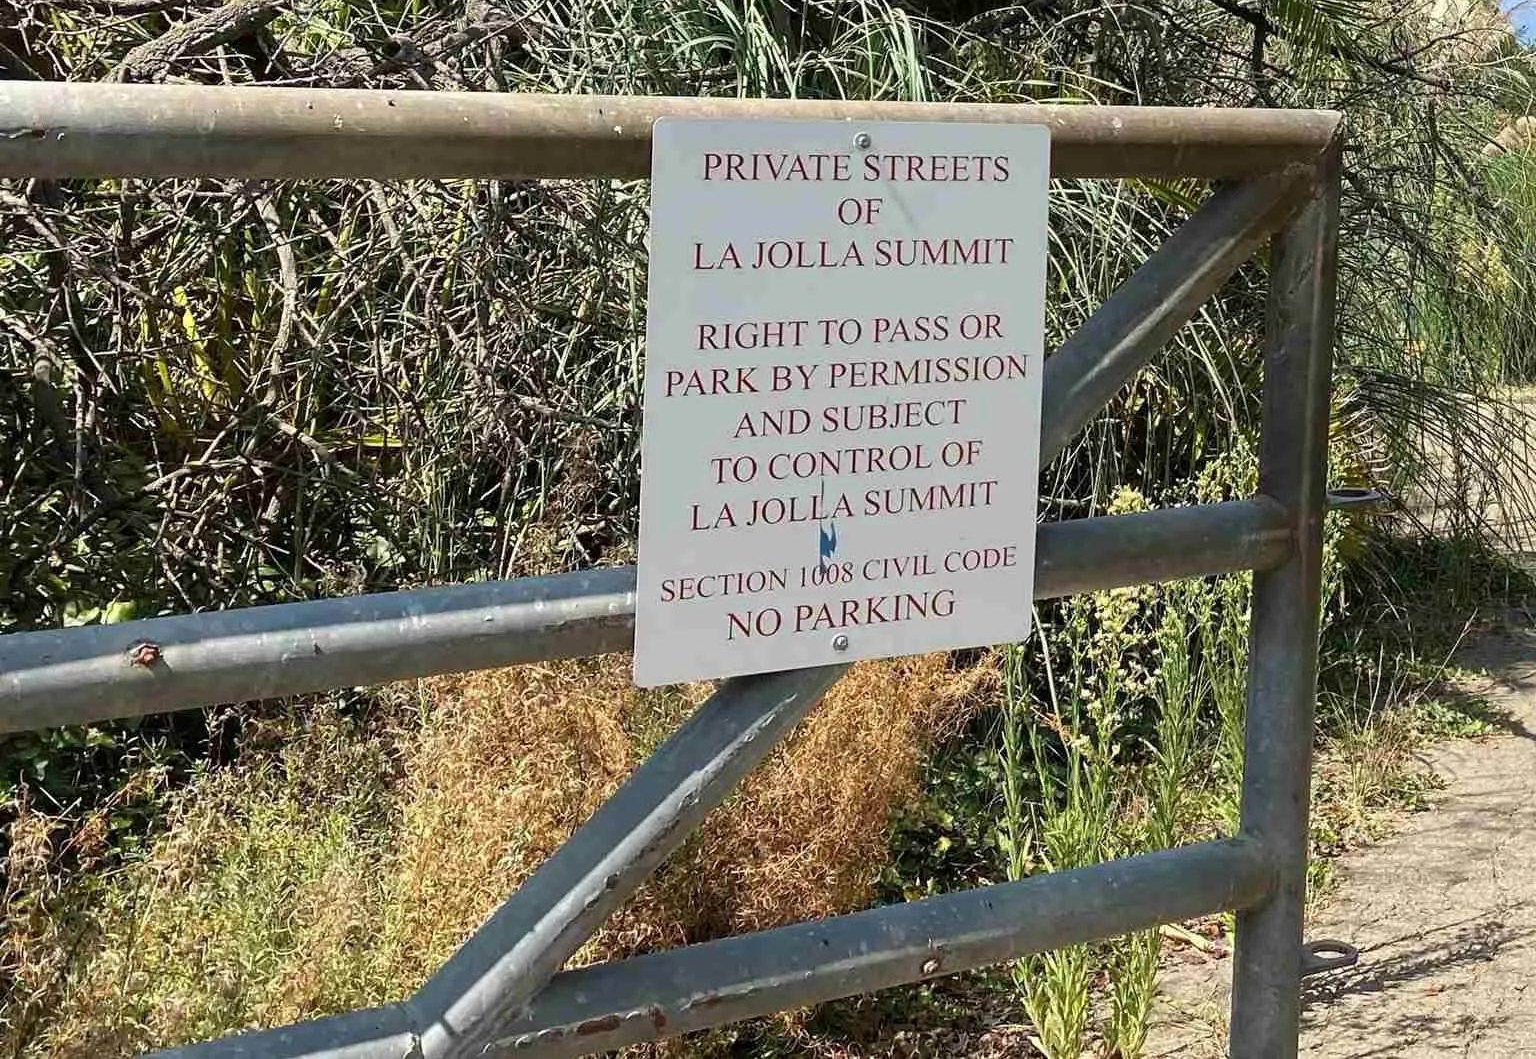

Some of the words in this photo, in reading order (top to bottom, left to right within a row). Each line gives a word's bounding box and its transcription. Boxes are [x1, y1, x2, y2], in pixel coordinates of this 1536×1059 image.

[704, 153, 851, 181] PRIVATE
[864, 155, 1010, 182] STREETS
[837, 198, 883, 225] OF
[694, 242, 742, 270] LA
[752, 241, 864, 269] JOLLA
[875, 238, 1013, 266] SUMMIT
[697, 321, 808, 350] RIGHT
[818, 319, 862, 345] TO
[874, 315, 949, 343] PASS
[960, 314, 1003, 339] OR
[666, 366, 758, 396] PARK
[772, 365, 819, 392] BY
[830, 355, 1028, 388] PERMISSION
[734, 409, 810, 438] AND
[823, 399, 967, 432] SUBJECT
[712, 456, 757, 484] TO
[768, 444, 932, 479] CONTROL
[942, 441, 983, 467] OF
[690, 504, 736, 531] LA
[747, 494, 853, 527] JOLLA
[864, 481, 998, 516] SUMMIT
[660, 568, 787, 602] SECTION
[800, 562, 853, 588] 1008
[863, 556, 936, 580] CIVIL
[944, 546, 1017, 572] CODE
[727, 608, 782, 640] NO
[794, 590, 956, 632] PARKING
